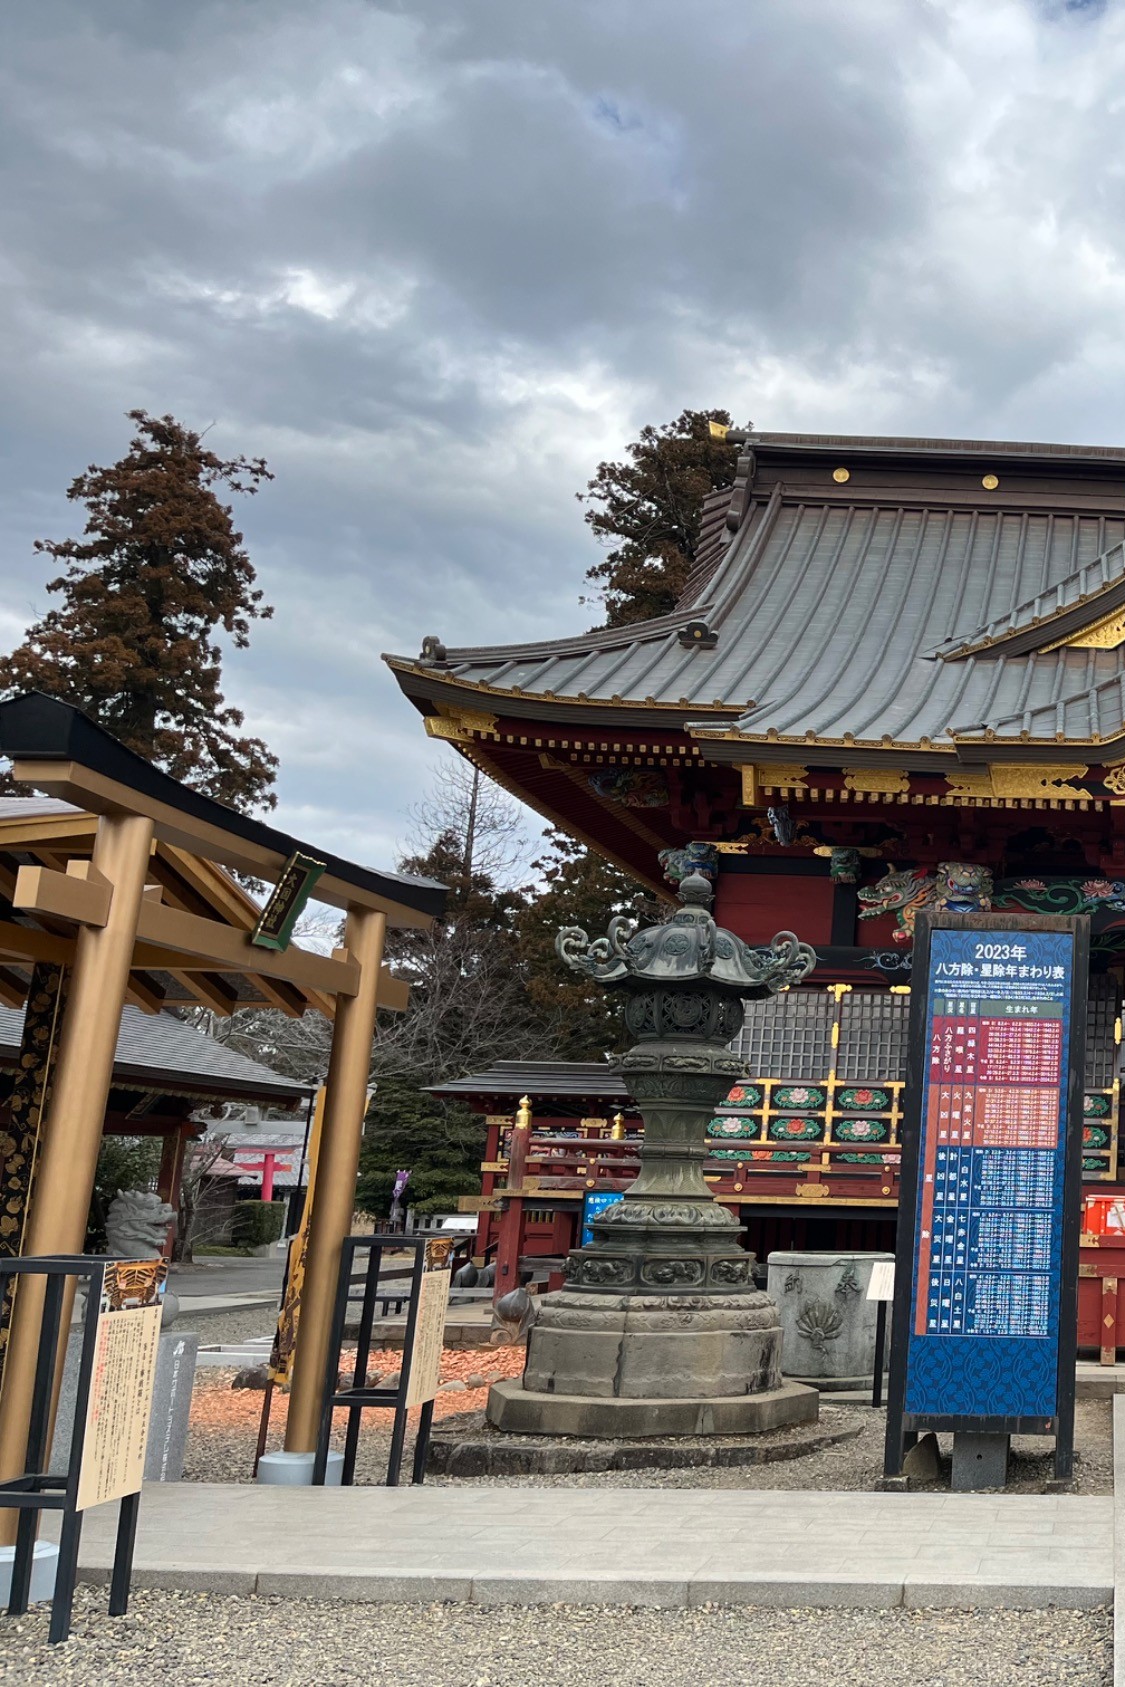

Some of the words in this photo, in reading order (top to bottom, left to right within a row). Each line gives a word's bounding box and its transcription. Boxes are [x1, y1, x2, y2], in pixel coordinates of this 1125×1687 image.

[975, 944, 1028, 962] 2023年
[935, 962, 1066, 980] 八方除・星除年まわり表
